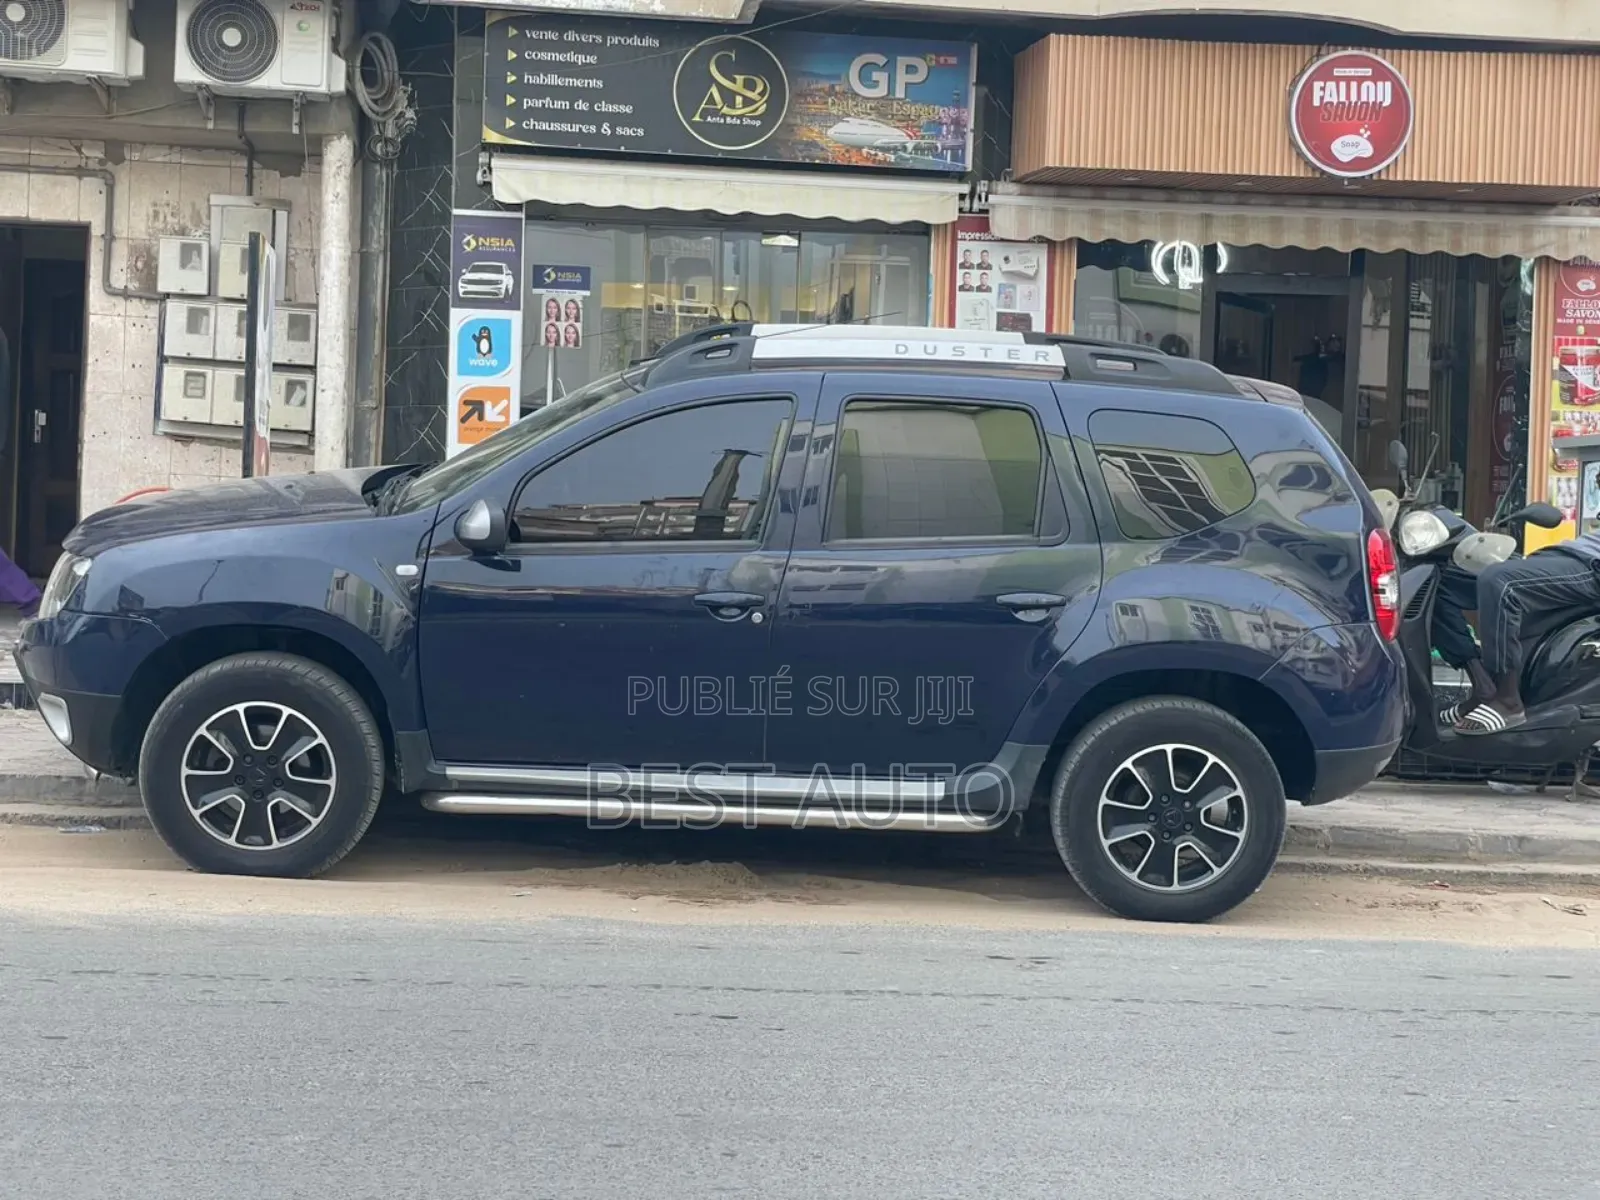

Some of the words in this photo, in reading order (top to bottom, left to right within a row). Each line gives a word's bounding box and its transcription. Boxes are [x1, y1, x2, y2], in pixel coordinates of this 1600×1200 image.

[525, 29, 559, 41] vente
[563, 30, 602, 44] divers
[606, 34, 660, 48] produits
[524, 49, 598, 65] cosmetique
[524, 72, 604, 89] habillements
[849, 53, 929, 99] GP
[523, 97, 570, 110] parfum
[574, 99, 590, 111] de
[594, 101, 634, 114] classe
[522, 118, 596, 133] chaussures
[601, 122, 611, 136] &
[616, 126, 645, 137] sacs
[706, 115, 725, 124] Anta
[742, 118, 762, 127] Shop
[479, 236, 515, 247] NSIA
[557, 271, 582, 280] NSIA
[895, 343, 1050, 362] DUSTER
[468, 359, 499, 367] wave
